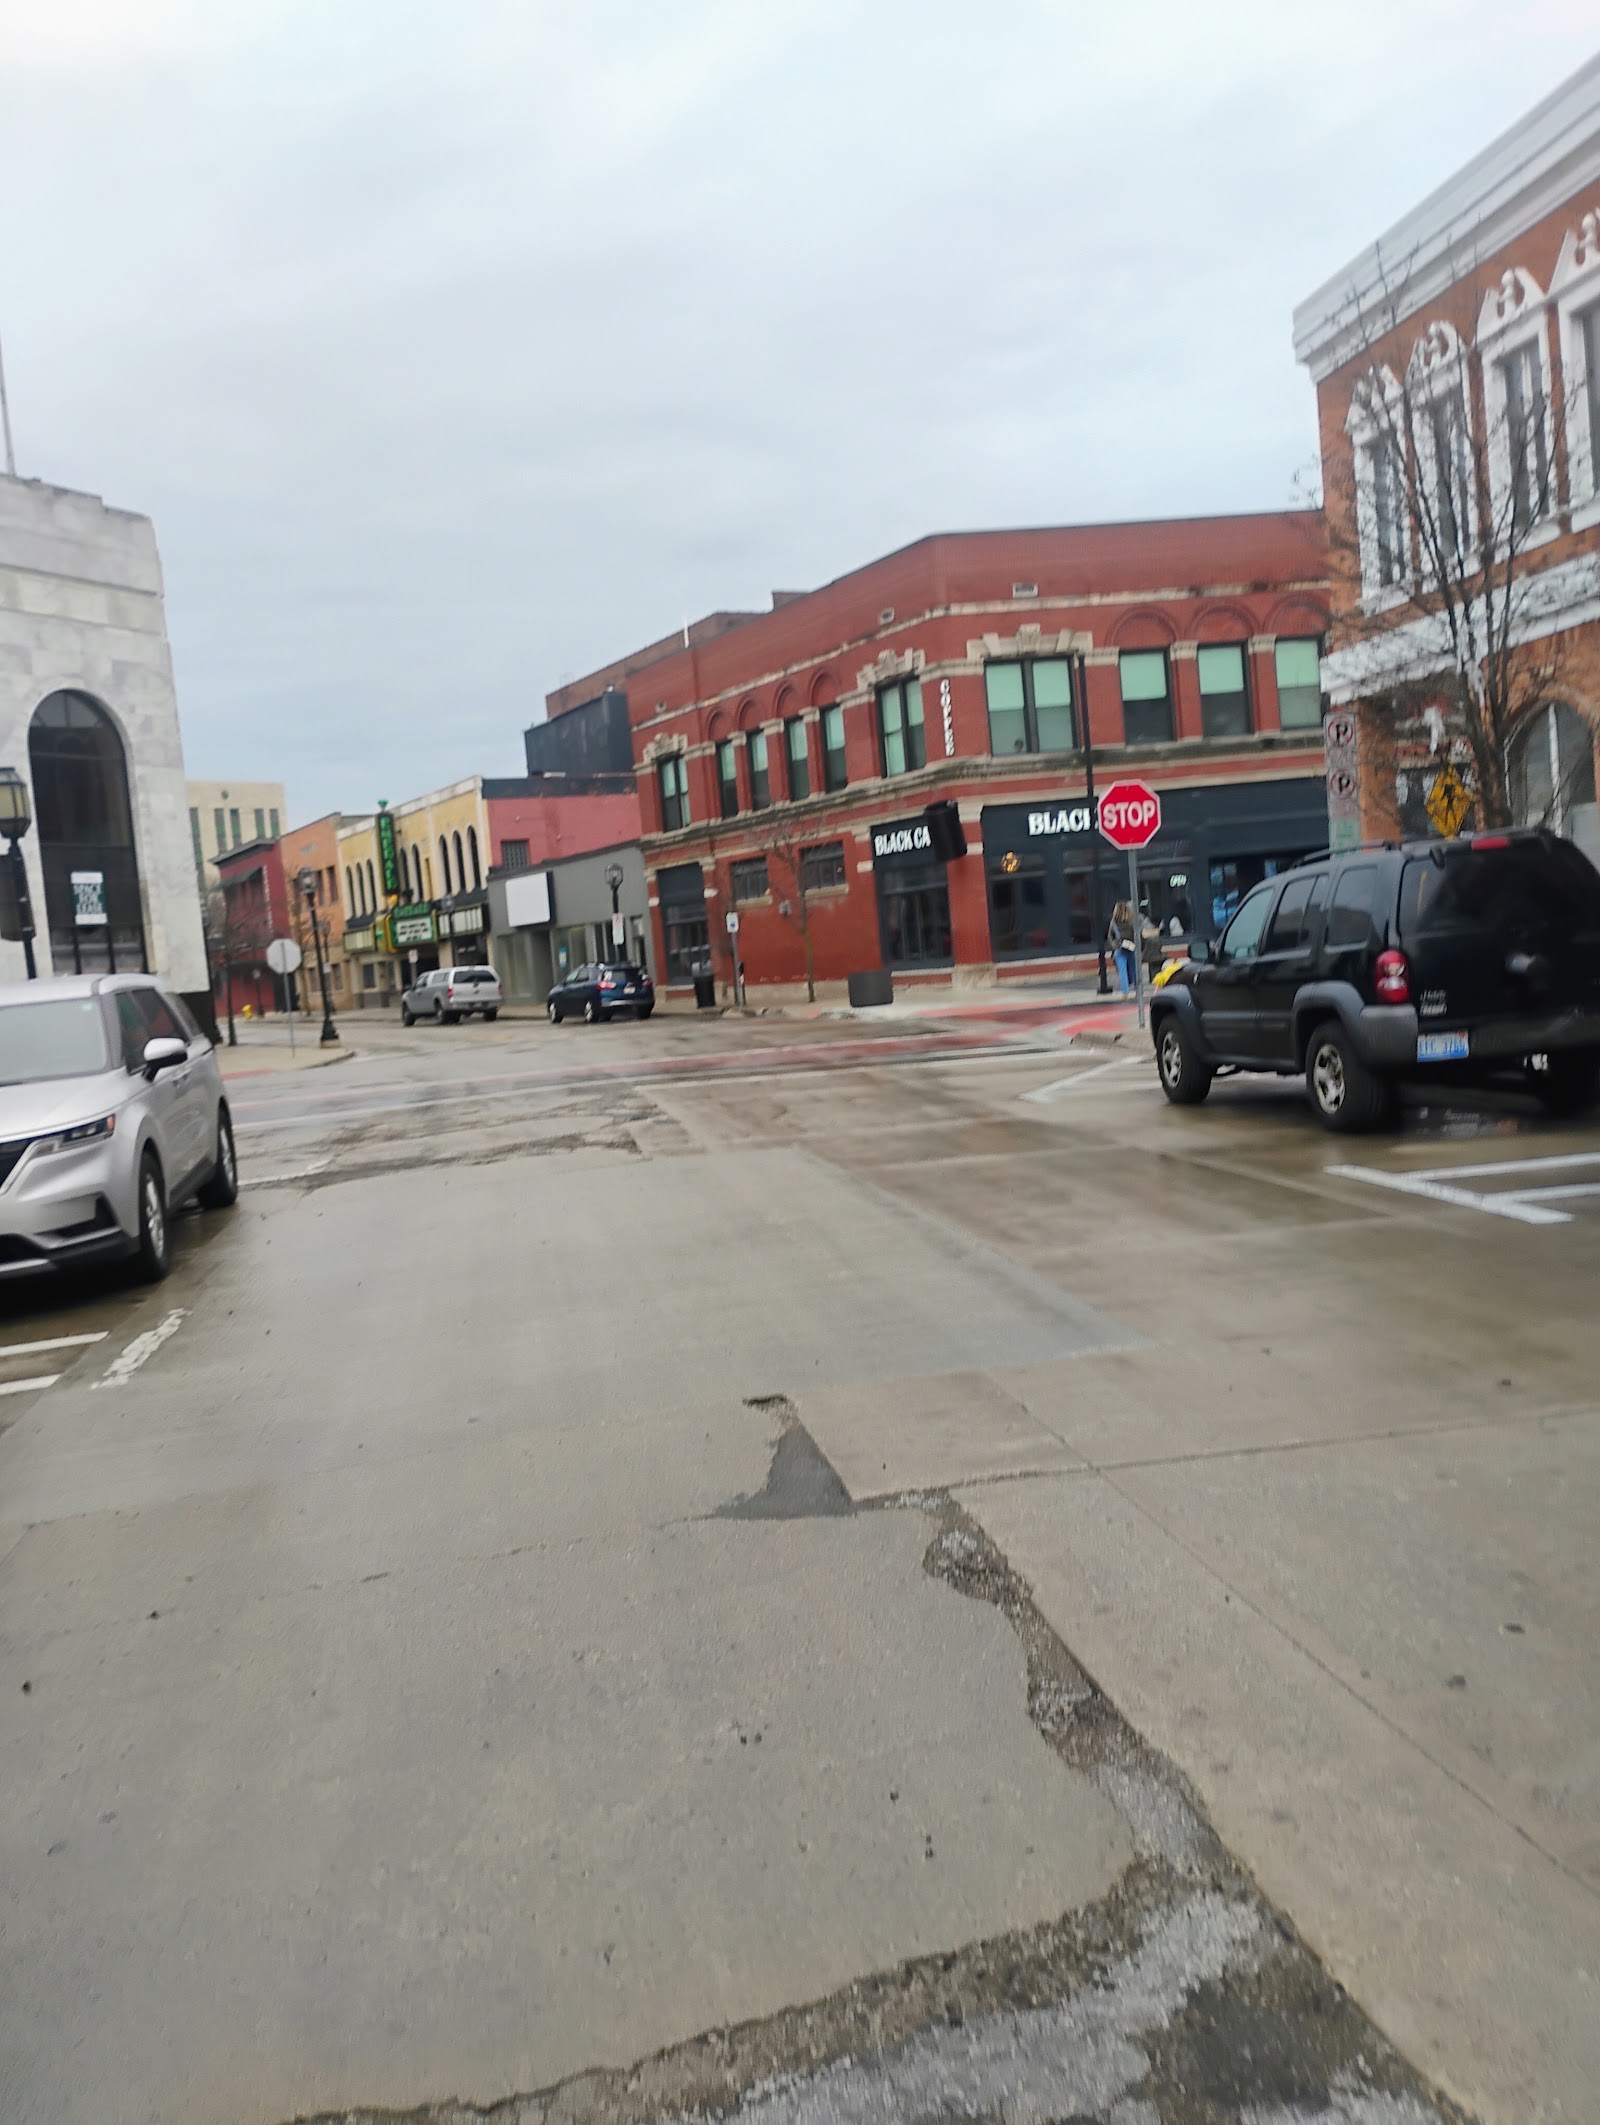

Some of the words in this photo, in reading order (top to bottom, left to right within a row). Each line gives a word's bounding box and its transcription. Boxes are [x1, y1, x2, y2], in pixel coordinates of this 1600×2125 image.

[940, 678, 955, 757] COFFEE
[1102, 799, 1156, 831] STOP
[874, 829, 913, 857] BLACK
